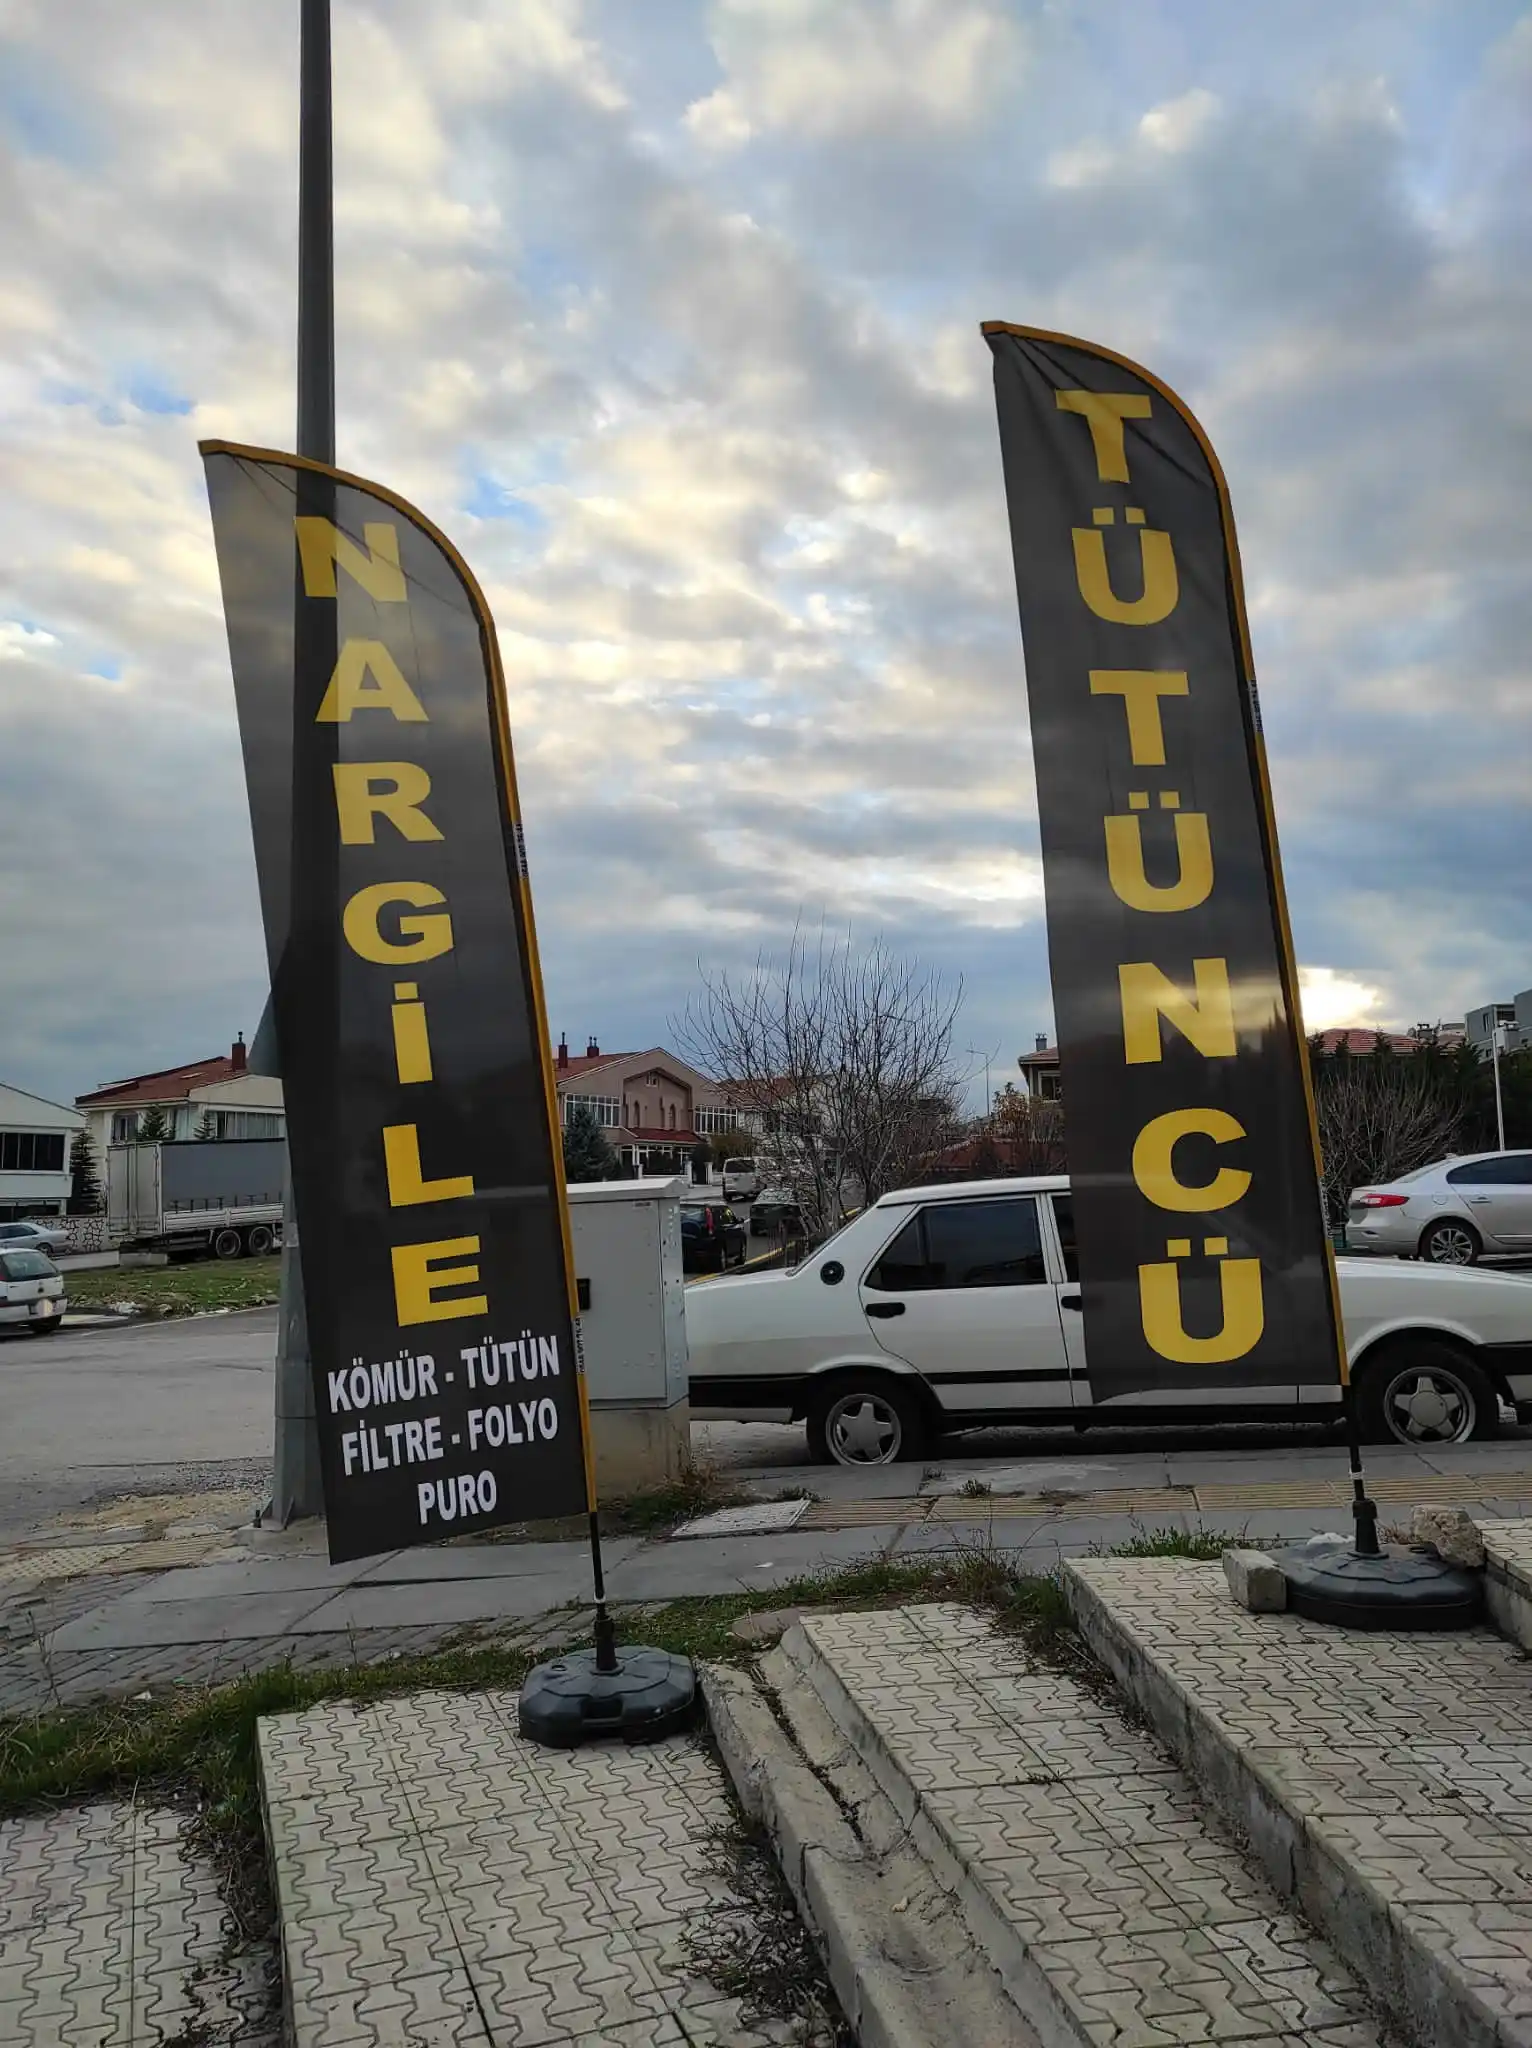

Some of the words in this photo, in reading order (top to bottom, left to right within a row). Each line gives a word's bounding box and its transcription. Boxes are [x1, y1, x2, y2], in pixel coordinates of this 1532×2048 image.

[1055, 389, 1264, 1364] TÜTÜNCÜ
[327, 1350, 438, 1413] KÖMÜR
[461, 1329, 560, 1388] TÜTÜN
[342, 1416, 444, 1475] FİLTRE
[467, 1398, 558, 1450] FOLYO
[418, 1470, 497, 1524] PURO
